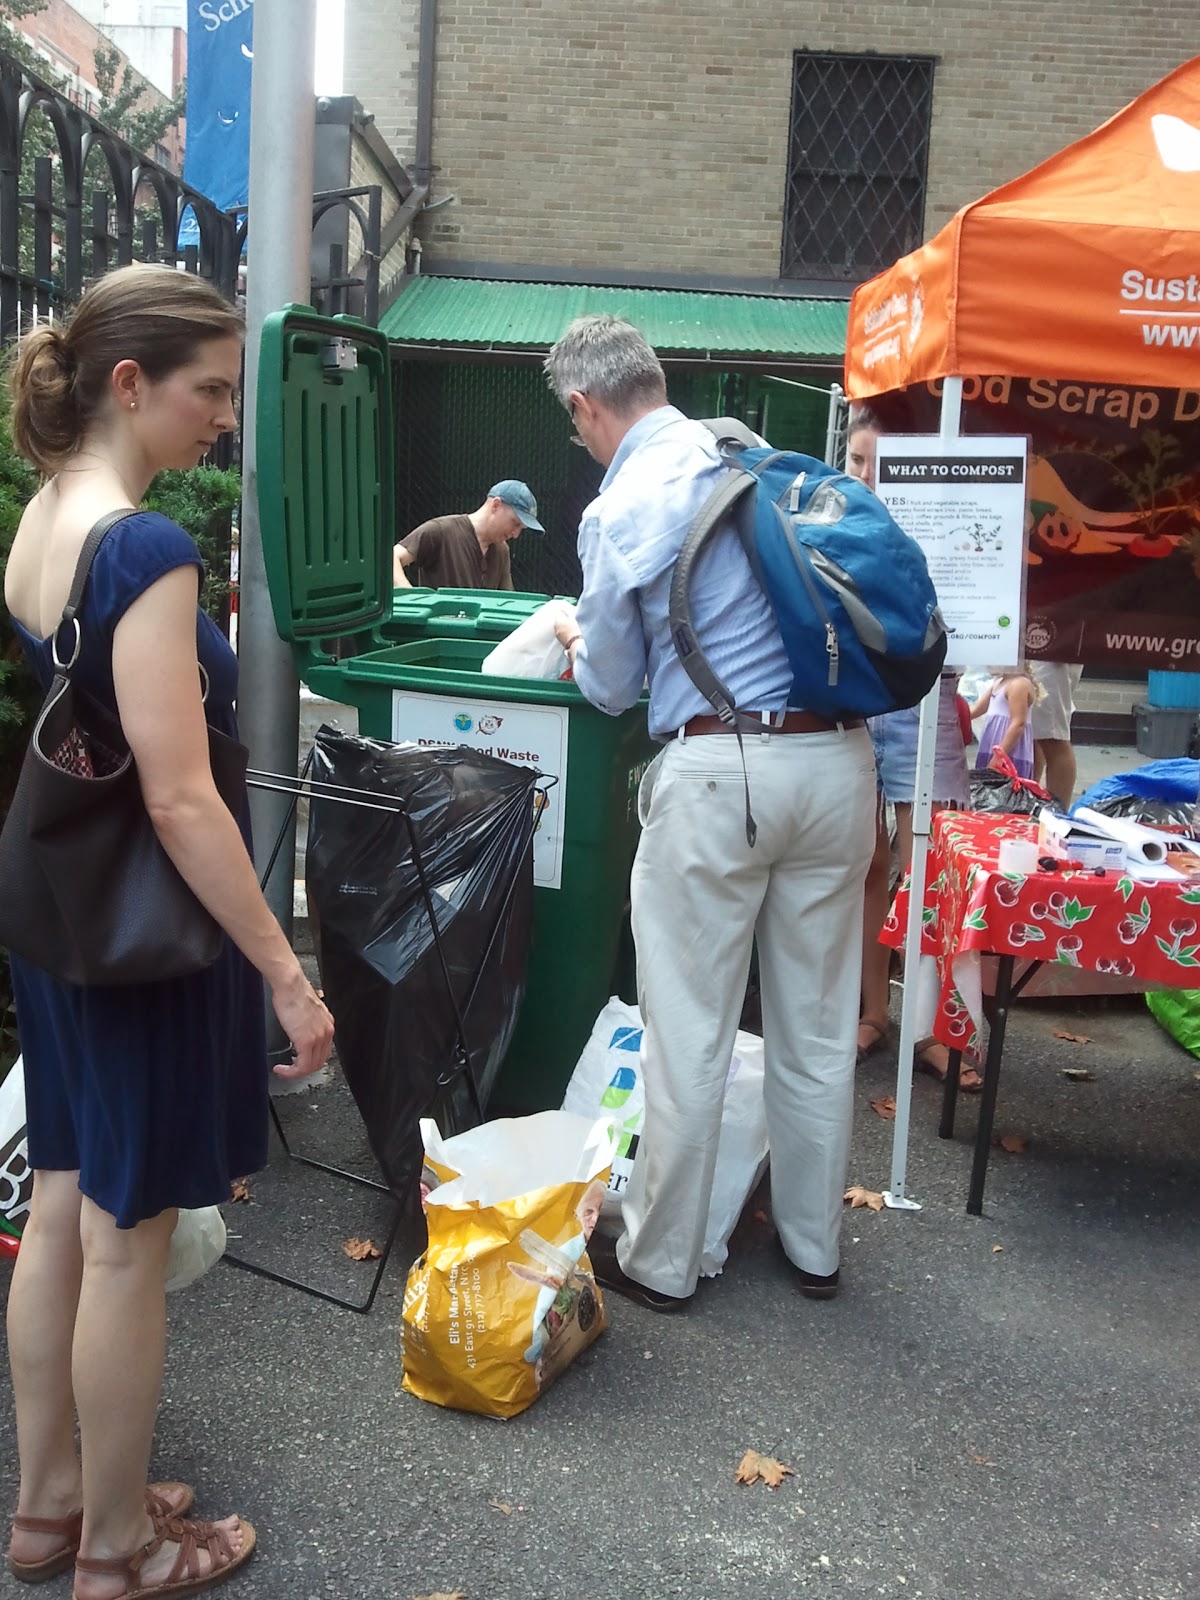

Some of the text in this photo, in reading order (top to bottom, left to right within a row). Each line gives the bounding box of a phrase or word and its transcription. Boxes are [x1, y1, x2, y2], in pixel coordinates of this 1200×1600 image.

[1121, 269, 1200, 302] Sust
[1142, 324, 1200, 348] ww
[1027, 377, 1160, 428] Scrap
[888, 465, 1014, 476] WHAT TO COMPOST
[497, 747, 540, 762] Waste
[449, 1321, 460, 1344] Eli's
[476, 1310, 487, 1333] (212)
[464, 1332, 474, 1351] East
